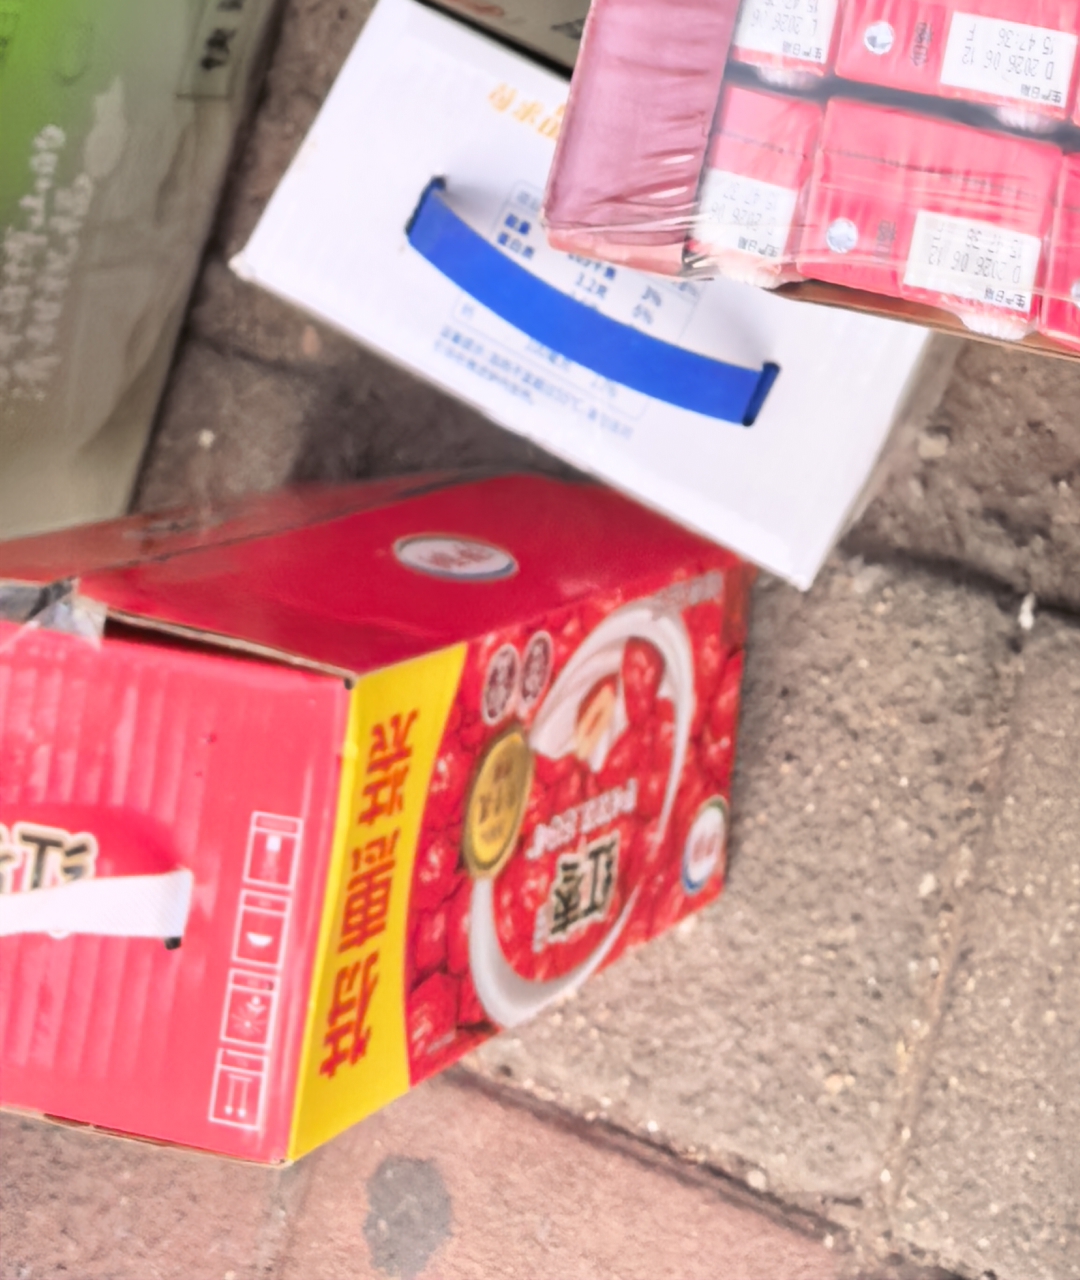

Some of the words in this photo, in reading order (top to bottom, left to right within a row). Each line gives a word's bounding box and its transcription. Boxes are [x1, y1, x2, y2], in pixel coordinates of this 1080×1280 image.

[319, 706, 420, 1080] 特惠装
[549, 838, 618, 936] 红枣
